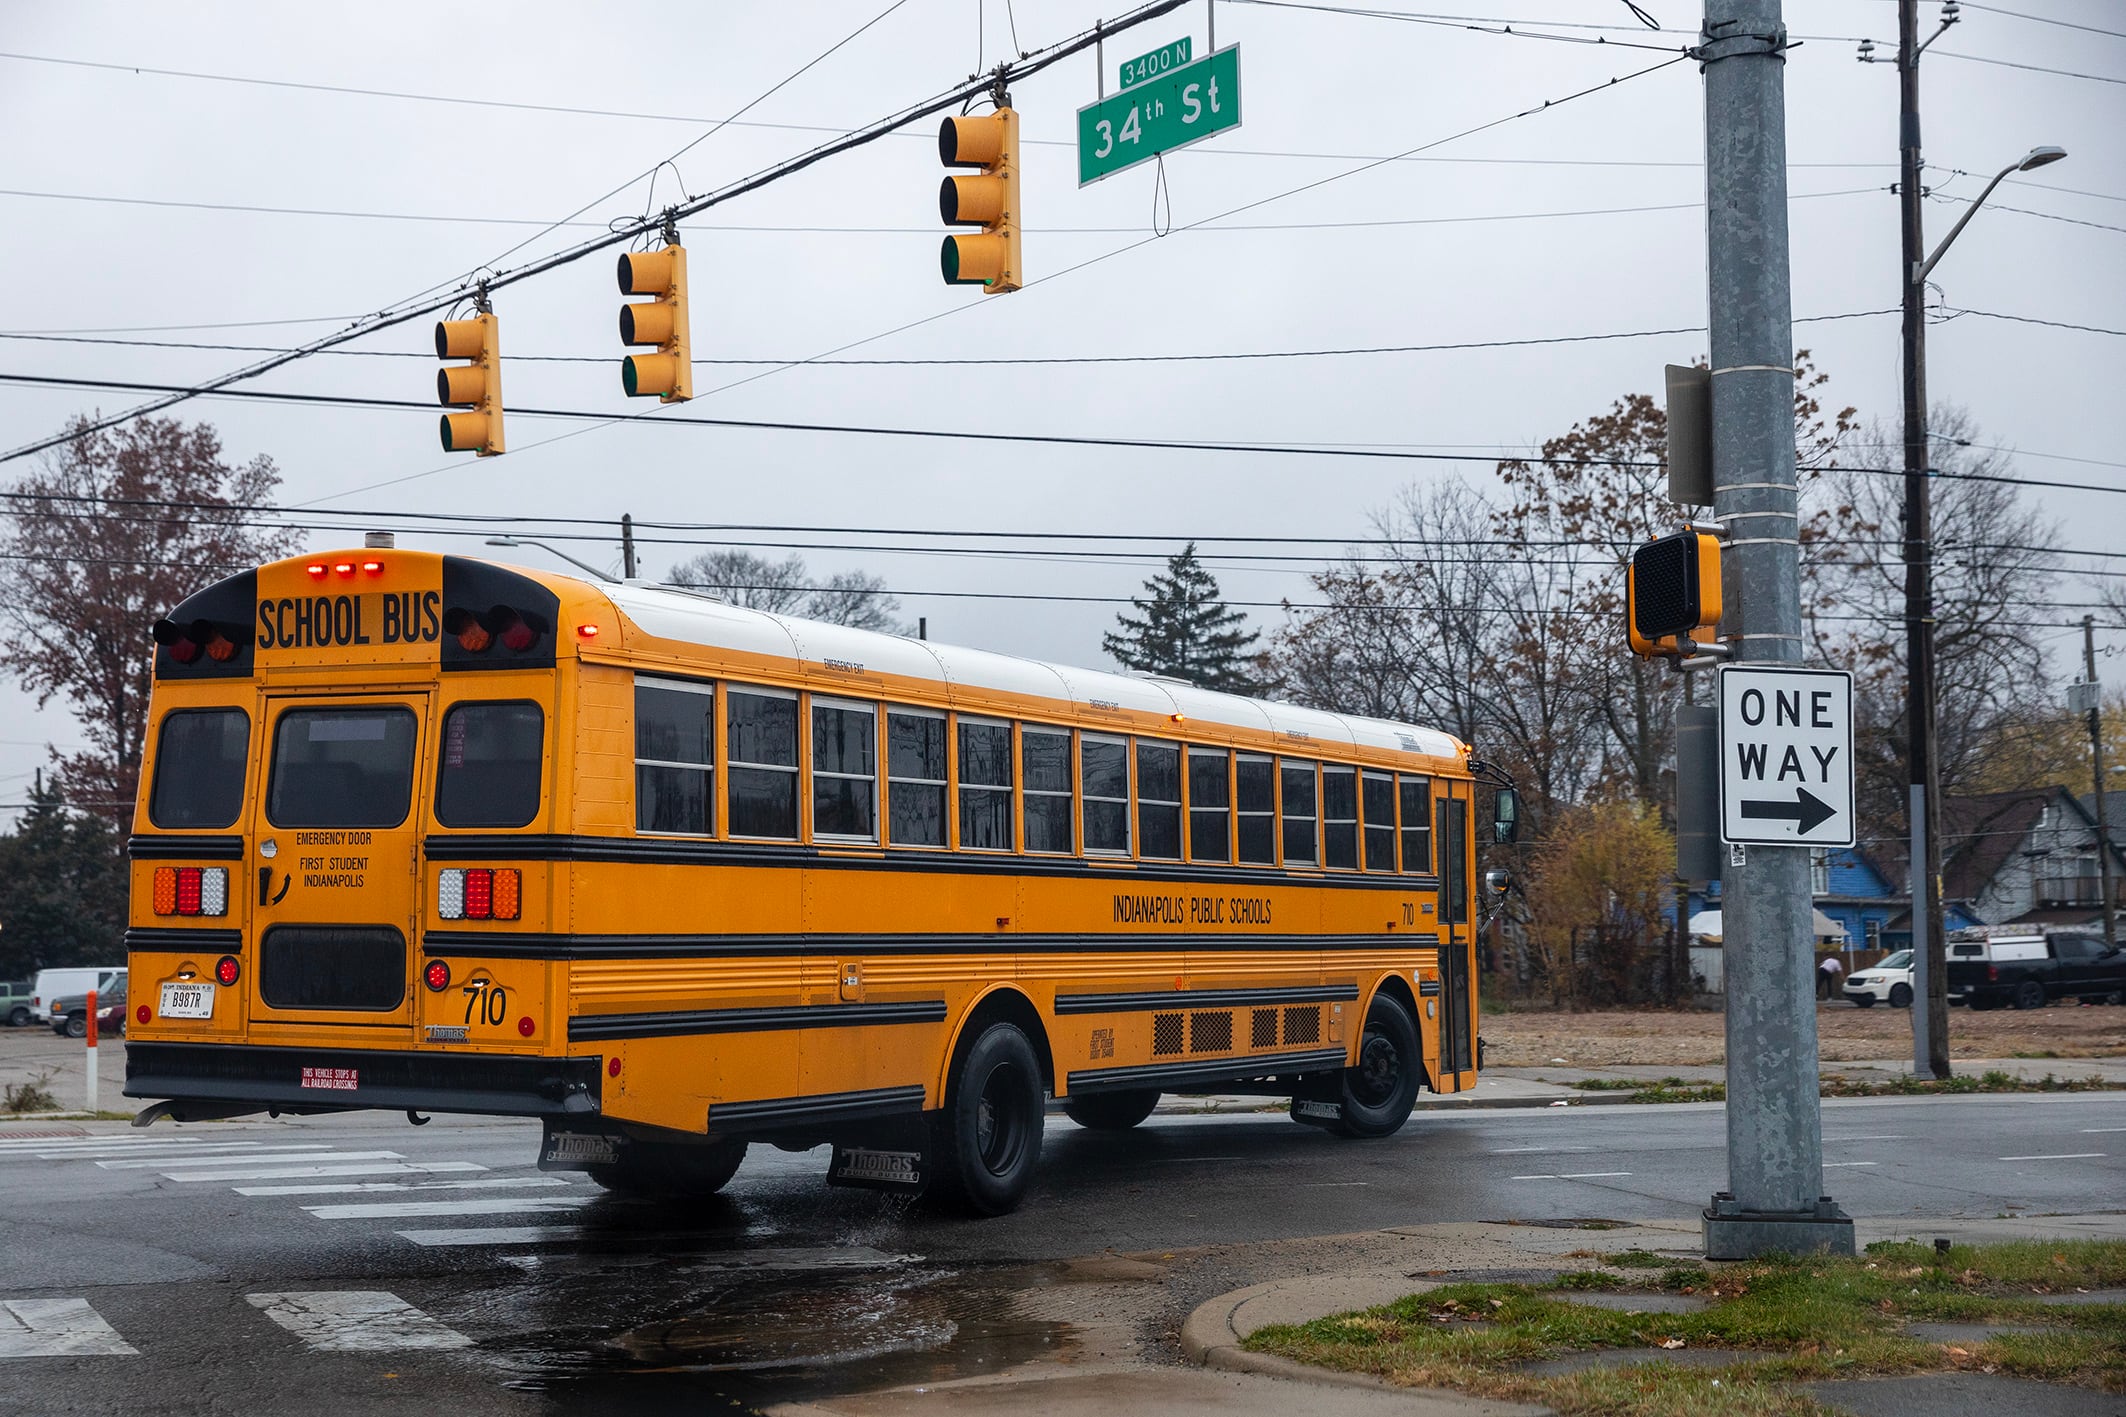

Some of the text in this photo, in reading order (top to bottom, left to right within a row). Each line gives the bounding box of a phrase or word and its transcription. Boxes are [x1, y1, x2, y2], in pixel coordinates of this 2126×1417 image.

[1125, 41, 1187, 85] 3400 N
[1094, 74, 1221, 159] 34th St
[258, 591, 440, 649] SCHOOL BUS
[823, 658, 853, 673] EMERGENCY
[1740, 688, 1834, 729] ONE
[1737, 743, 1839, 783] WAY
[296, 832, 372, 846] EMERGENCY DOOR
[300, 857, 369, 870] FIRST STUDENT
[303, 874, 365, 888] INDIANAPOLIS
[1113, 895, 1272, 924] INDIANAPOLIS PUBLIC SCHOOLS
[1402, 903, 1415, 926] 710
[172, 991, 202, 1008] B987R
[463, 987, 507, 1027] 710
[425, 1024, 470, 1039] Thomas
[301, 1077, 358, 1090] ALL RAILROAD CROSSINGS
[303, 1067, 357, 1080] THIS VEHICLE STOPS AT
[551, 1130, 621, 1154] Thomas
[842, 1147, 921, 1172] Thomas
